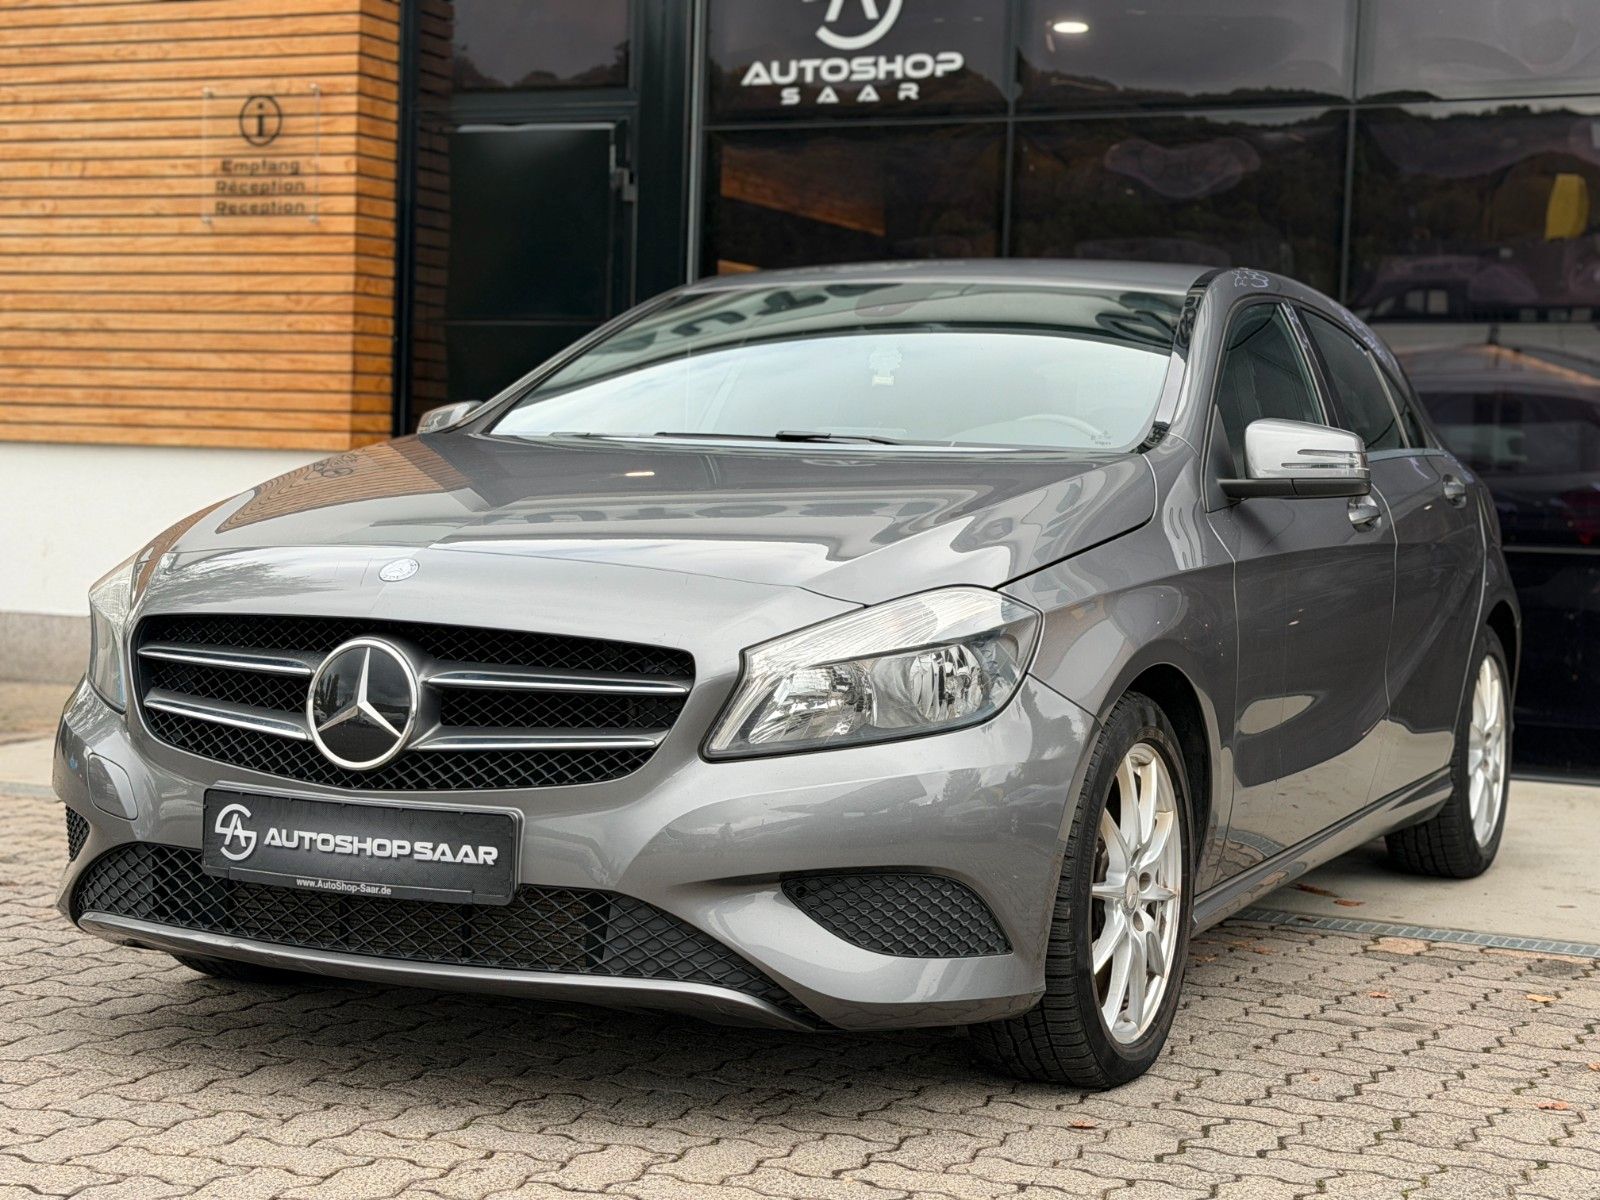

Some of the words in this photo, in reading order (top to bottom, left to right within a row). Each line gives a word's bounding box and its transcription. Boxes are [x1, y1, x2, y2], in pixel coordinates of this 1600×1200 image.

[741, 52, 964, 86] AUTOSHOP
[780, 82, 919, 106] SAAR
[221, 159, 300, 176] Empfang
[215, 200, 305, 215] Reception
[296, 878, 392, 895] www.AutoShop-Saar.de
